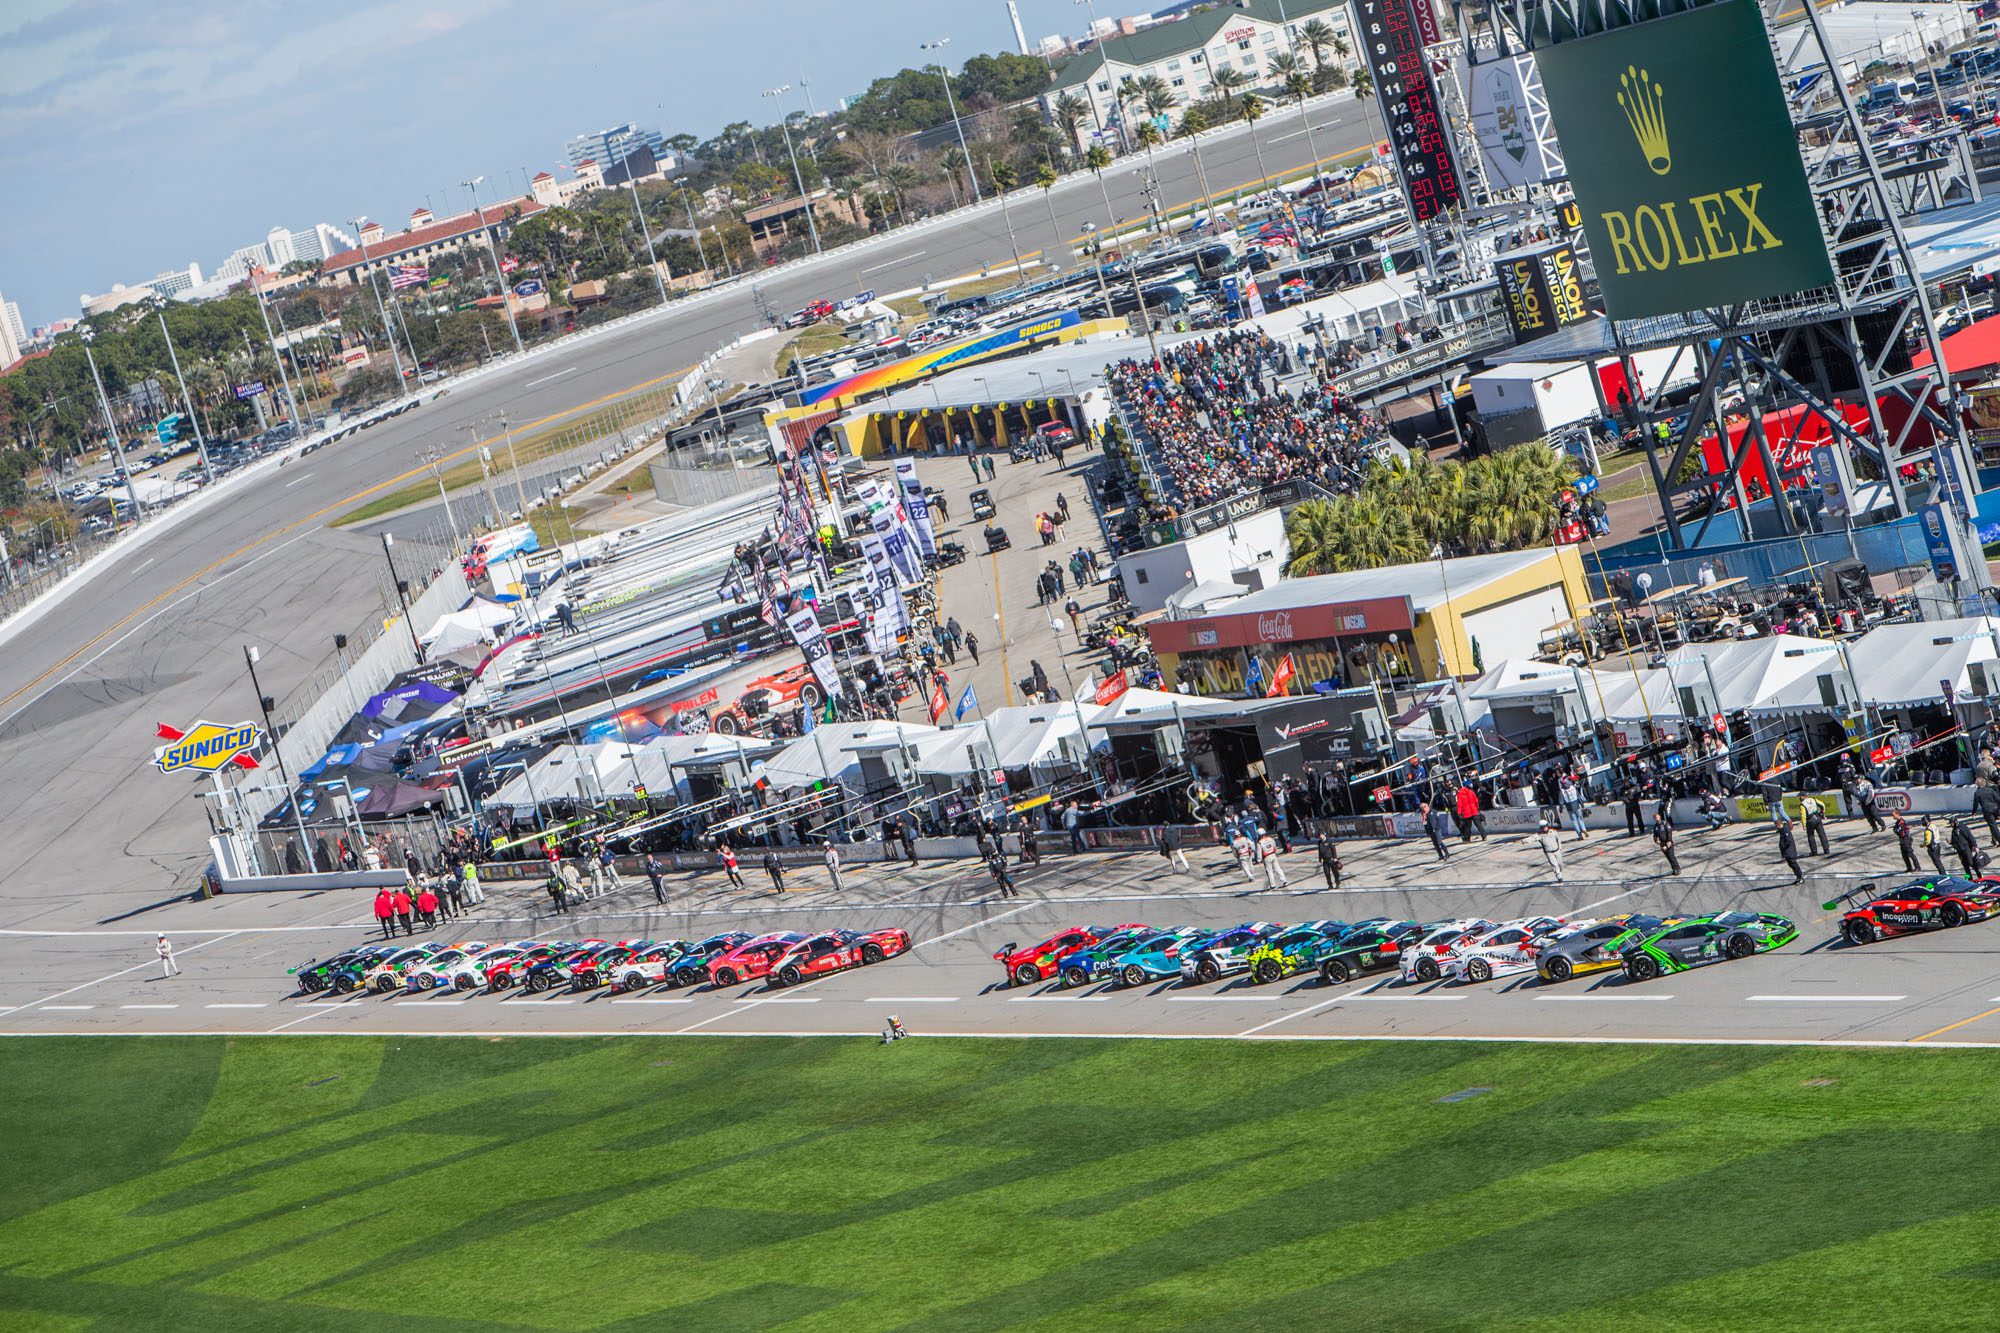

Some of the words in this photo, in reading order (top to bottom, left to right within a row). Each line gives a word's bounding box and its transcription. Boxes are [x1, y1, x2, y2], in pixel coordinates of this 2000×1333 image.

[1365, 2, 1374, 14] 7
[1231, 26, 1255, 36] Hilton
[1371, 23, 1381, 34] 8
[1376, 43, 1386, 55] 9
[1379, 61, 1397, 76] 10
[1385, 82, 1401, 96] 11
[1390, 102, 1408, 116] 12
[1496, 104, 1517, 130] 24
[1396, 122, 1414, 136] 13
[1402, 142, 1419, 156] 14
[1407, 162, 1425, 176] 15
[1411, 177, 1435, 200] 20
[1601, 183, 1783, 275] ROLEX
[1542, 255, 1570, 325] FANDECK
[1555, 250, 1587, 320] UNOH
[1502, 264, 1528, 331] FANDECK
[1514, 260, 1545, 329] UNOH
[1019, 317, 1062, 339] SUNOCO
[1385, 359, 1411, 376] UNOH
[1444, 337, 1468, 354] UNOH
[300, 399, 420, 458] DAYTONA
[912, 506, 927, 519] 22
[1229, 495, 1260, 516] UNOH
[888, 544, 901, 555] 11
[1342, 613, 1367, 630] NASCAR
[810, 641, 827, 660] 31
[168, 727, 251, 767] SUNOCO
[1883, 747, 1893, 758] 62
[1668, 756, 1681, 767] 11
[1377, 791, 1388, 801] 02
[947, 806, 955, 815] 60
[1491, 813, 1536, 827] CADILLAC
[755, 827, 765, 835] 01
[1882, 912, 1918, 922] Inception
[1467, 951, 1528, 963] WeatherTech
